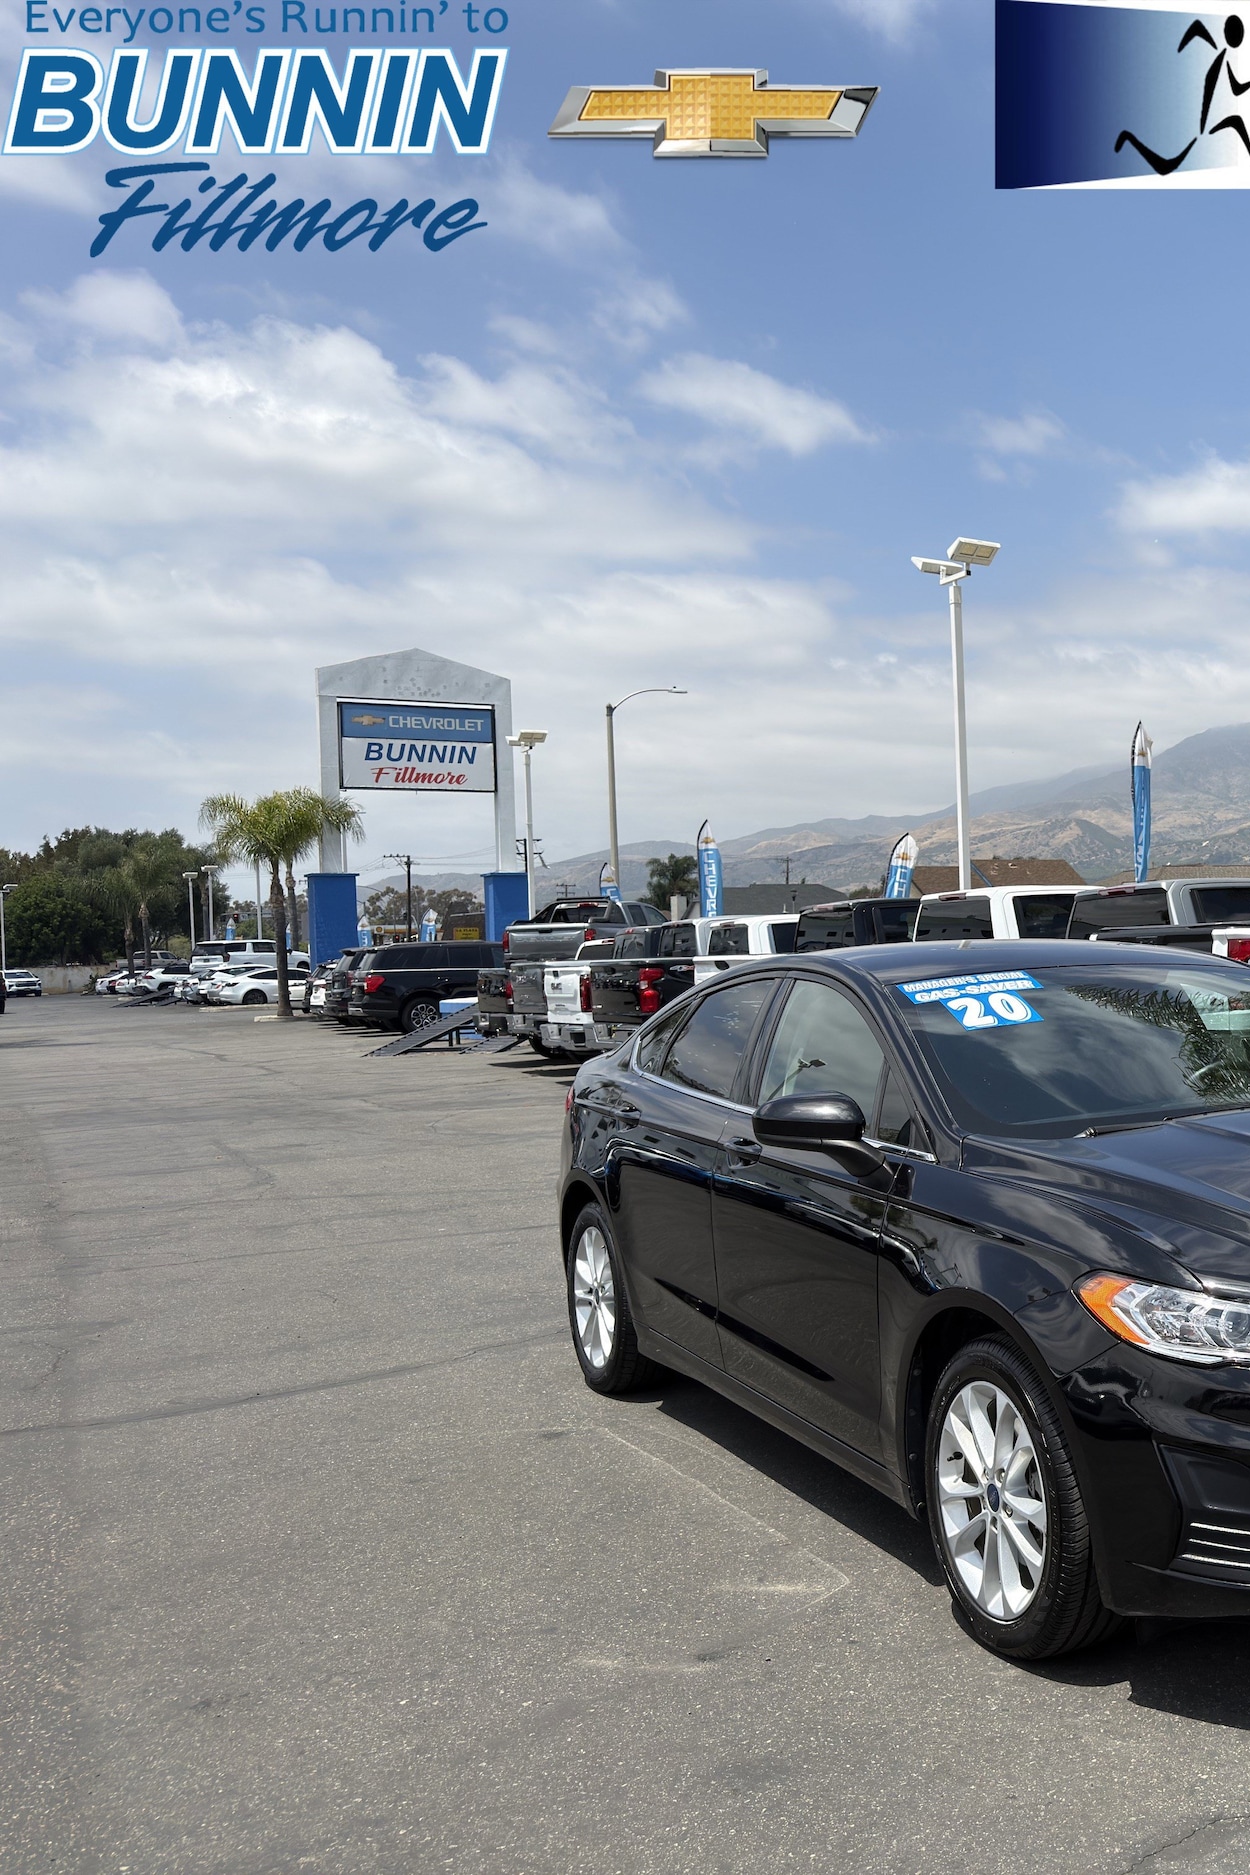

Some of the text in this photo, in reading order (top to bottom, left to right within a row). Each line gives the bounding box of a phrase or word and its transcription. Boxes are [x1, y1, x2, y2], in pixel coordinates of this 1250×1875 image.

[388, 715, 484, 732] CHEVROLET
[364, 742, 477, 765] BUNNIN
[370, 766, 468, 786] Fillmore
[903, 970, 1028, 992] MANAGER'S SPECIAL
[914, 979, 1035, 1003] GAS-SAVER
[946, 992, 1032, 1028] 20
